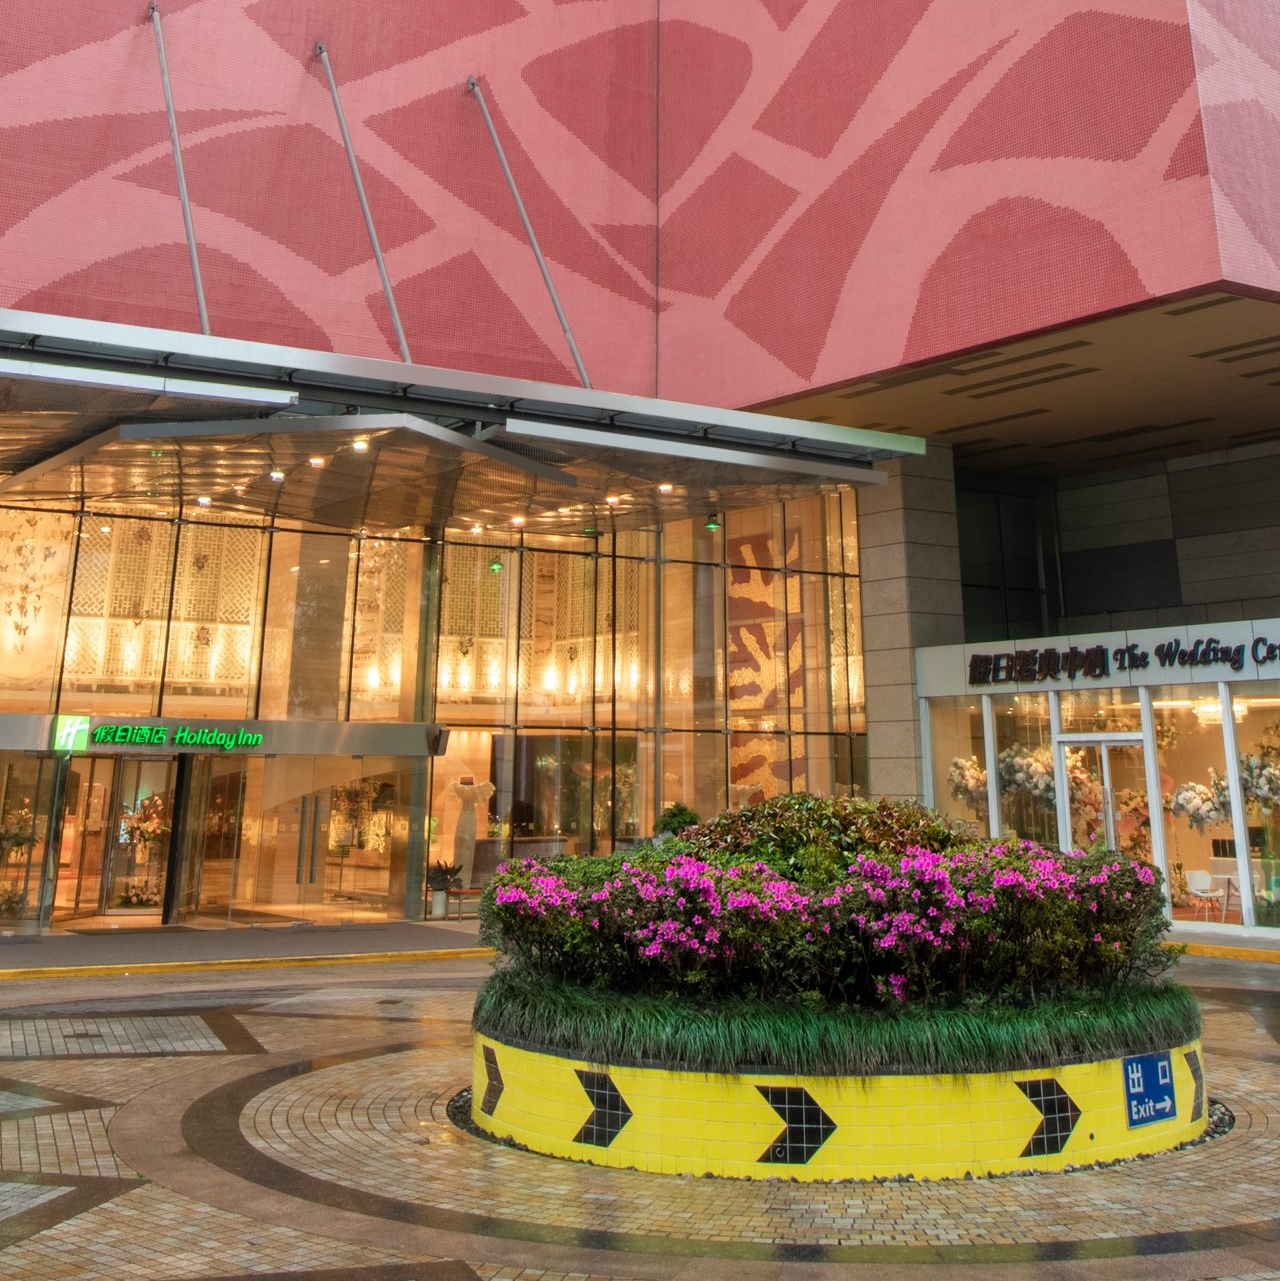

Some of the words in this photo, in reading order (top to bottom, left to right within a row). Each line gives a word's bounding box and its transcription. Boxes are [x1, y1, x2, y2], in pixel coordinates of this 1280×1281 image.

[1113, 643, 1149, 670] The
[1154, 638, 1245, 671] Wedding
[93, 725, 168, 744] 假日酒店
[173, 726, 236, 749] Holiday
[237, 727, 264, 746] Inn
[1127, 1060, 1170, 1094] 出口
[1131, 1098, 1155, 1120] Exit
